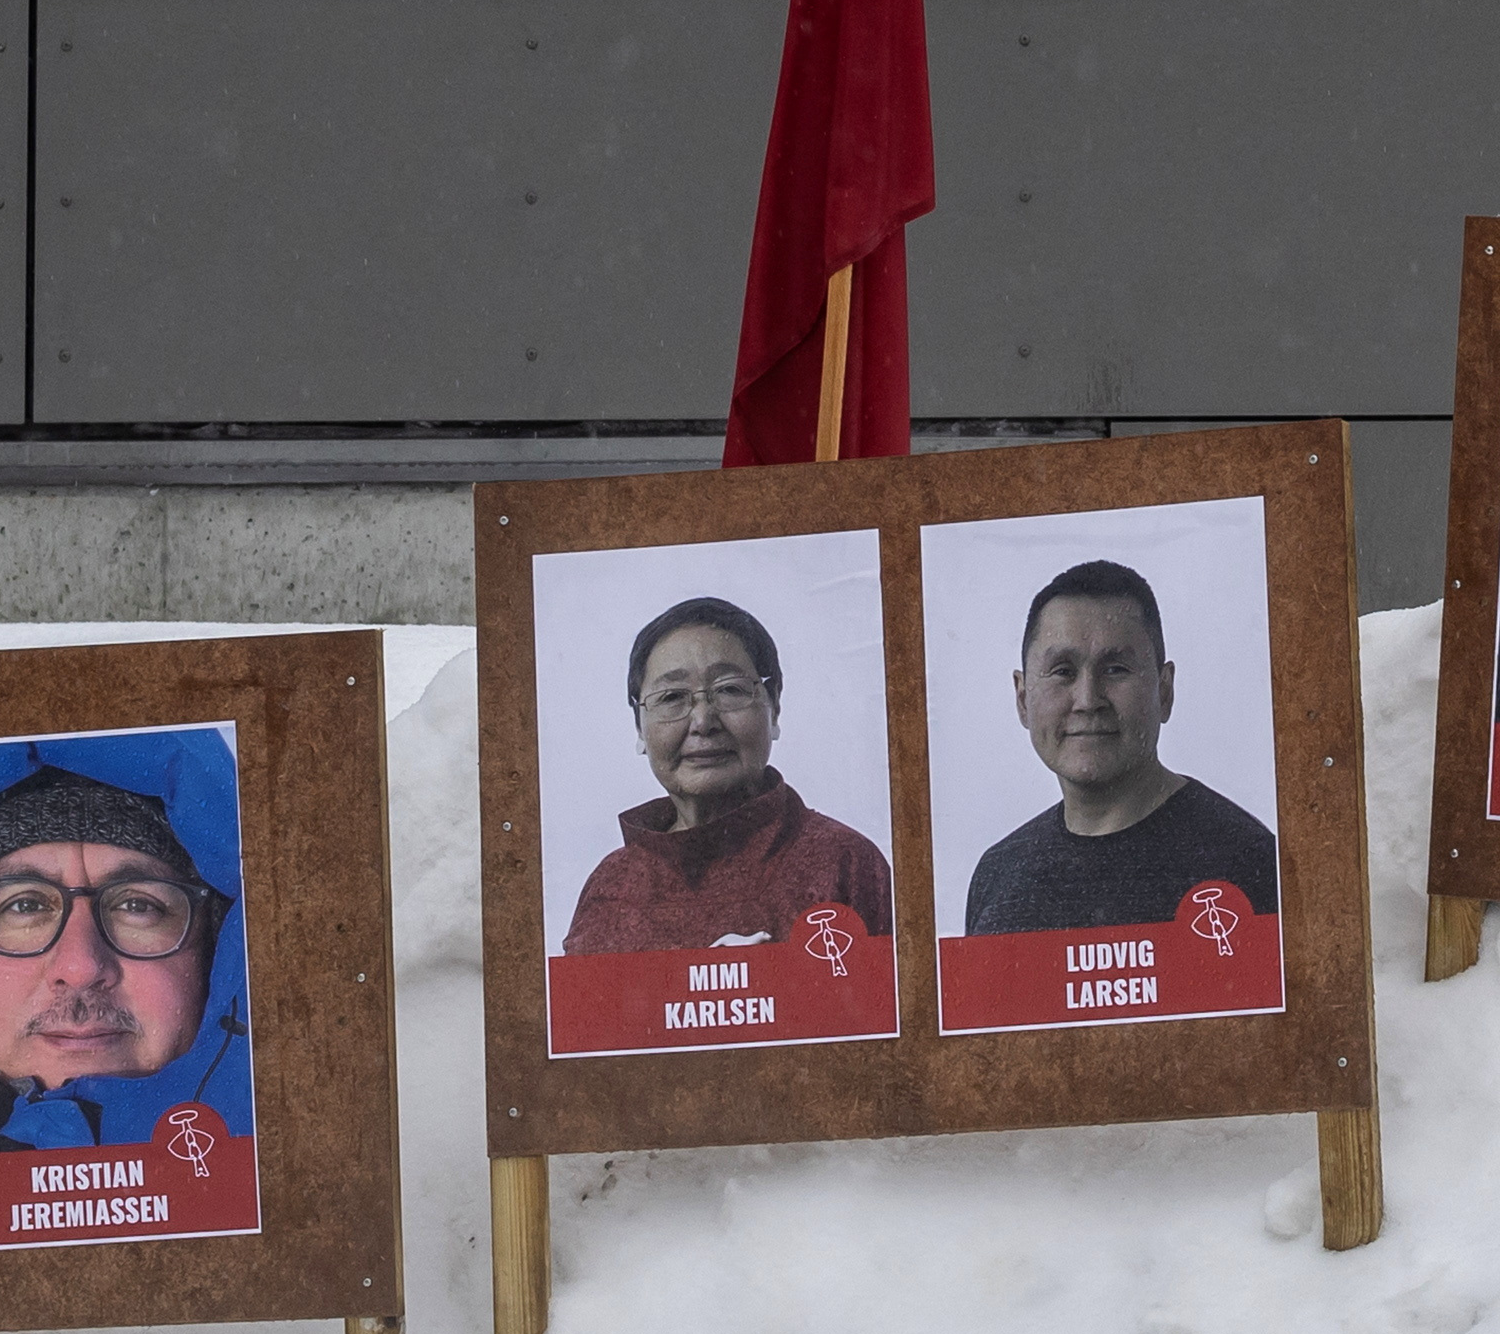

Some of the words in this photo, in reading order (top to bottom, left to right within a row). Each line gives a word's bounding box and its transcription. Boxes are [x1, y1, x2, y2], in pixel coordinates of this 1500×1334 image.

[1066, 939, 1155, 972] LUDVIG
[689, 962, 749, 992] MIMI
[1066, 976, 1158, 1009] LARSEN
[665, 996, 775, 1030] KARLSEN
[31, 1159, 144, 1194] KRISTIAN
[10, 1195, 169, 1232] JEREMIASSEN
